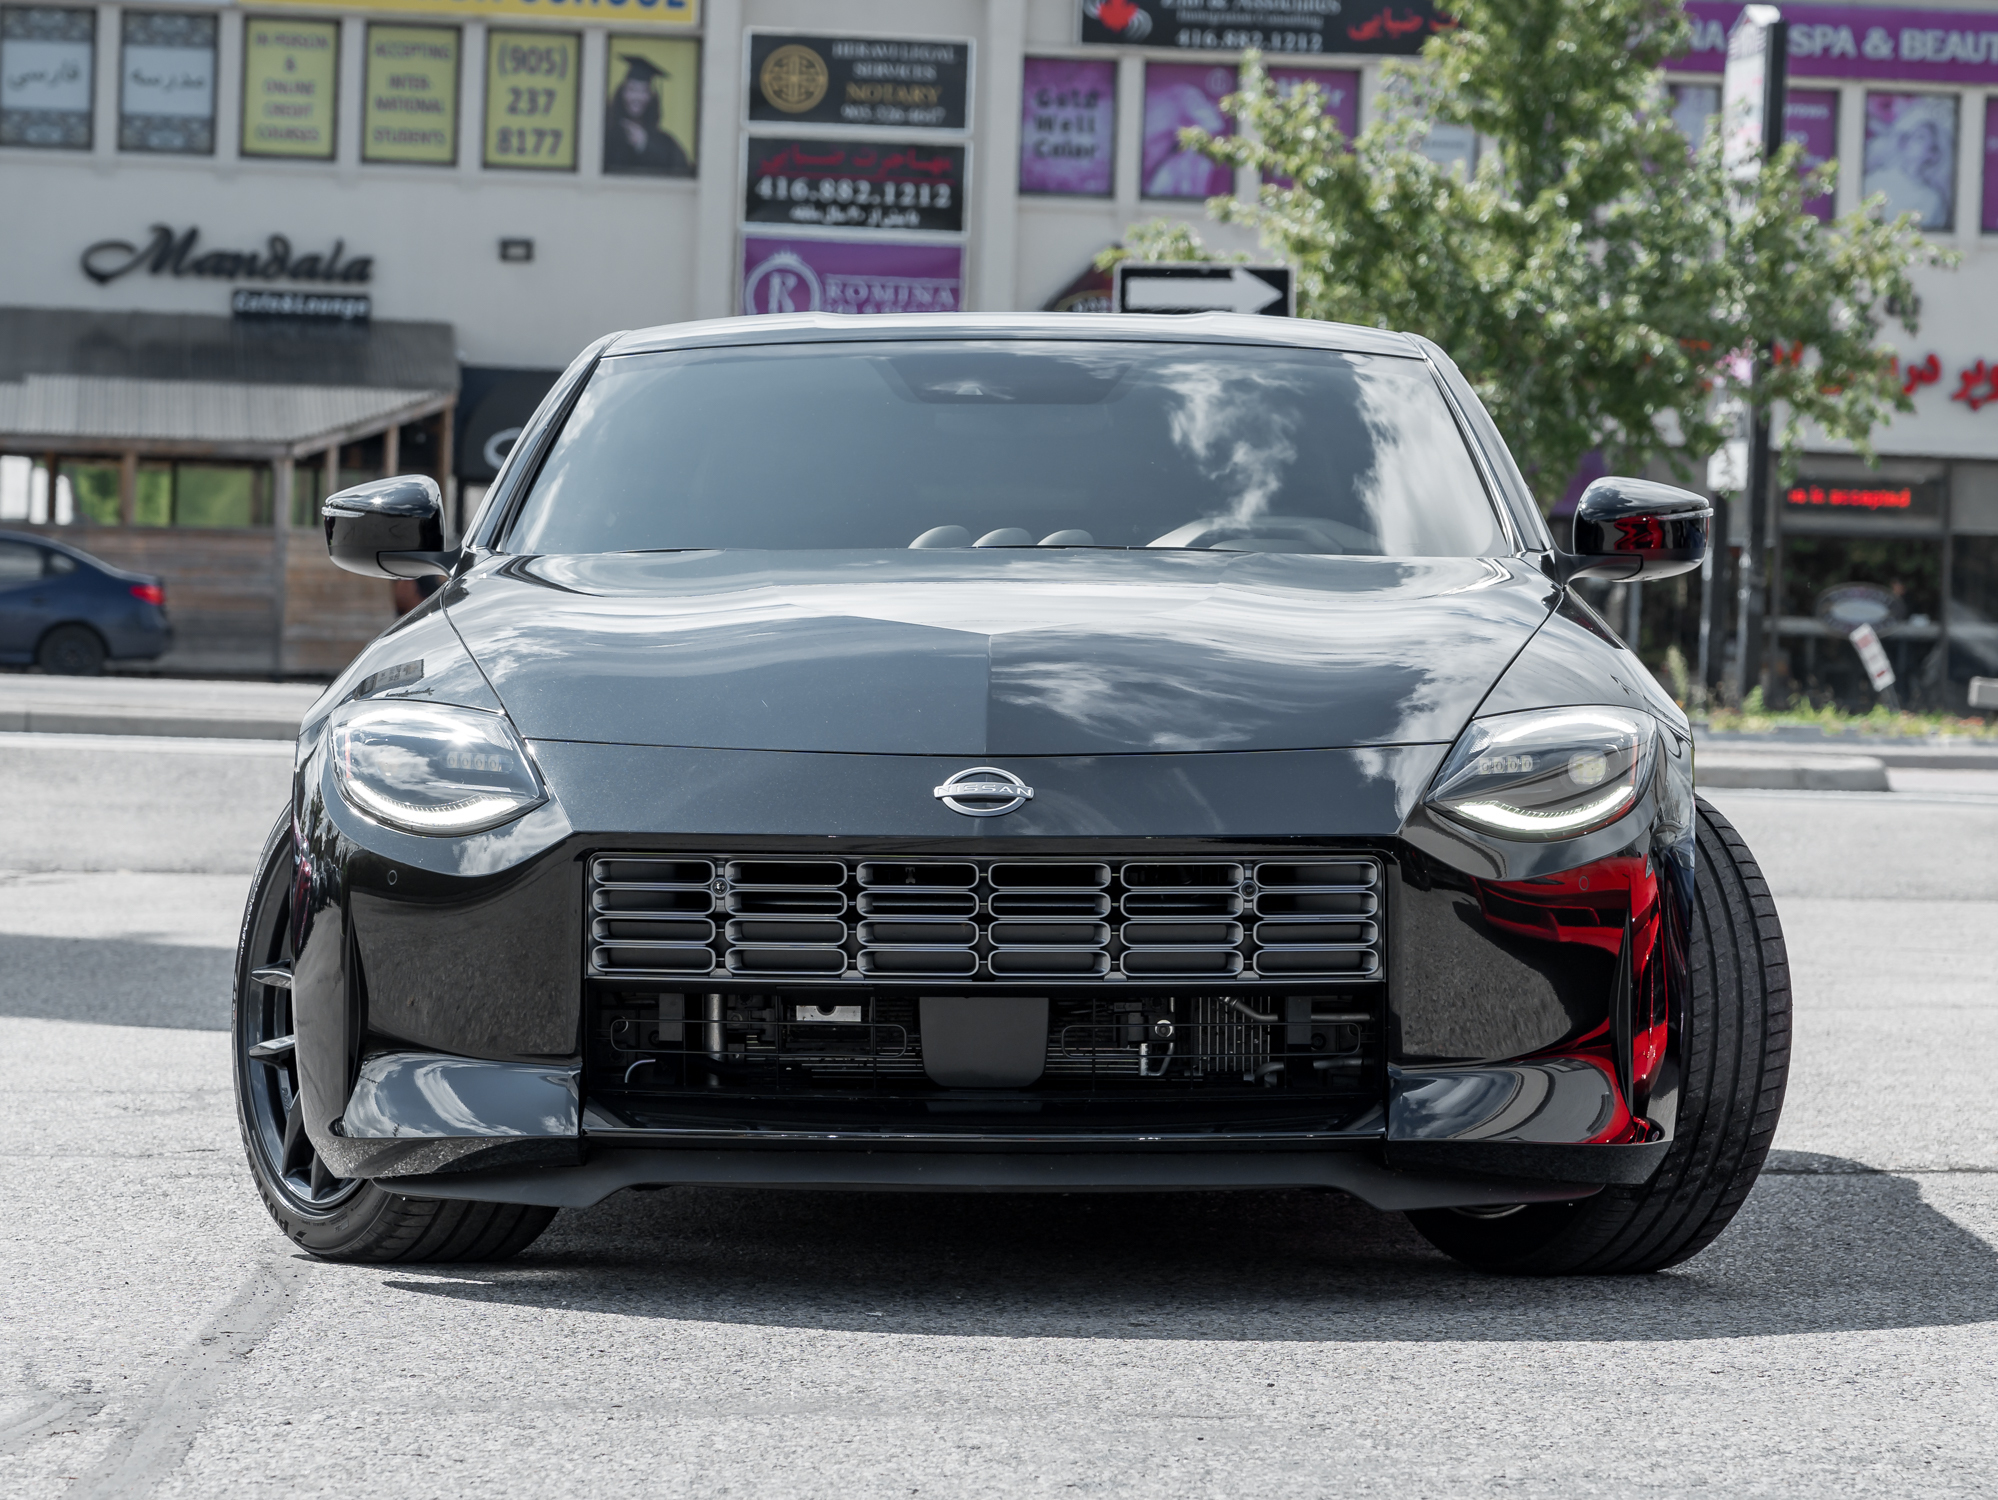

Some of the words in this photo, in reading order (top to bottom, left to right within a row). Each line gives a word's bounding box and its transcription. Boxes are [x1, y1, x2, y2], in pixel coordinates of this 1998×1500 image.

[1176, 29, 1322, 50] 416.882.1212
[1787, 25, 1856, 59] SPA
[1862, 27, 1894, 60] &
[373, 42, 452, 61] ACCEPTING
[498, 42, 569, 80] (905)
[853, 61, 936, 79] SERVICES
[373, 96, 446, 114] NATIONAL
[506, 86, 557, 116] 237
[846, 82, 942, 105] NOTARY
[1034, 113, 1096, 135] Well
[371, 129, 446, 146] STUDENTS
[495, 126, 564, 156] 8177
[756, 176, 951, 207] 416.882.1212
[80, 223, 375, 285] Mandala
[825, 281, 954, 305] ROMINA
[937, 783, 1032, 797] NISSAN
